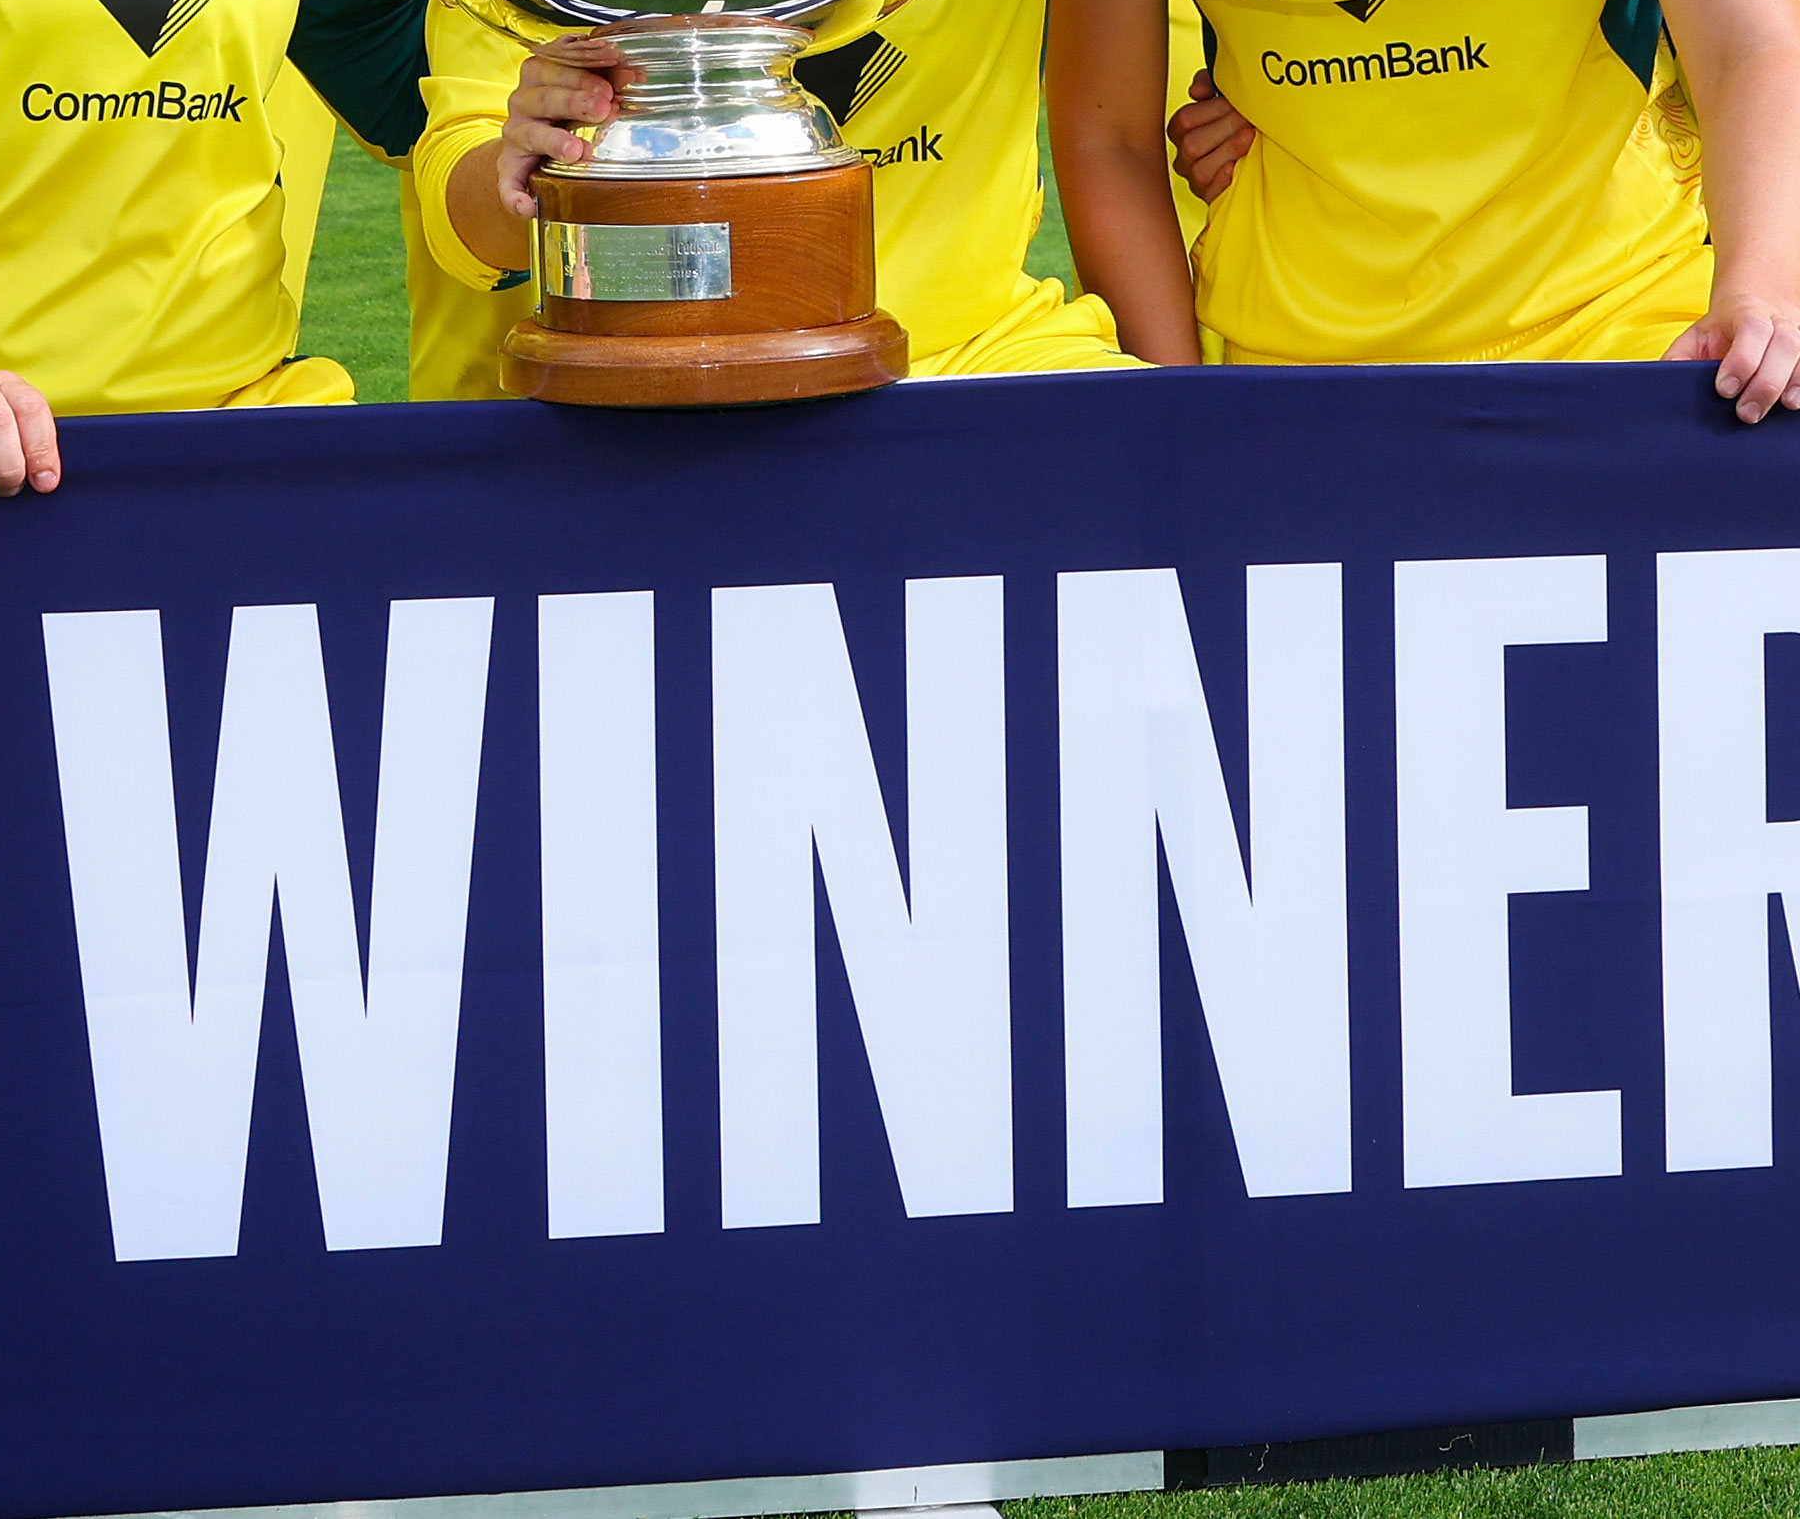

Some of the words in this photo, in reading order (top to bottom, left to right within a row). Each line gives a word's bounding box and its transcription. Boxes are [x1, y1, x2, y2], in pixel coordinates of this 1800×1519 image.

[1261, 35, 1490, 87] CommBank
[21, 80, 249, 123] CommBank
[860, 124, 944, 170] Bank
